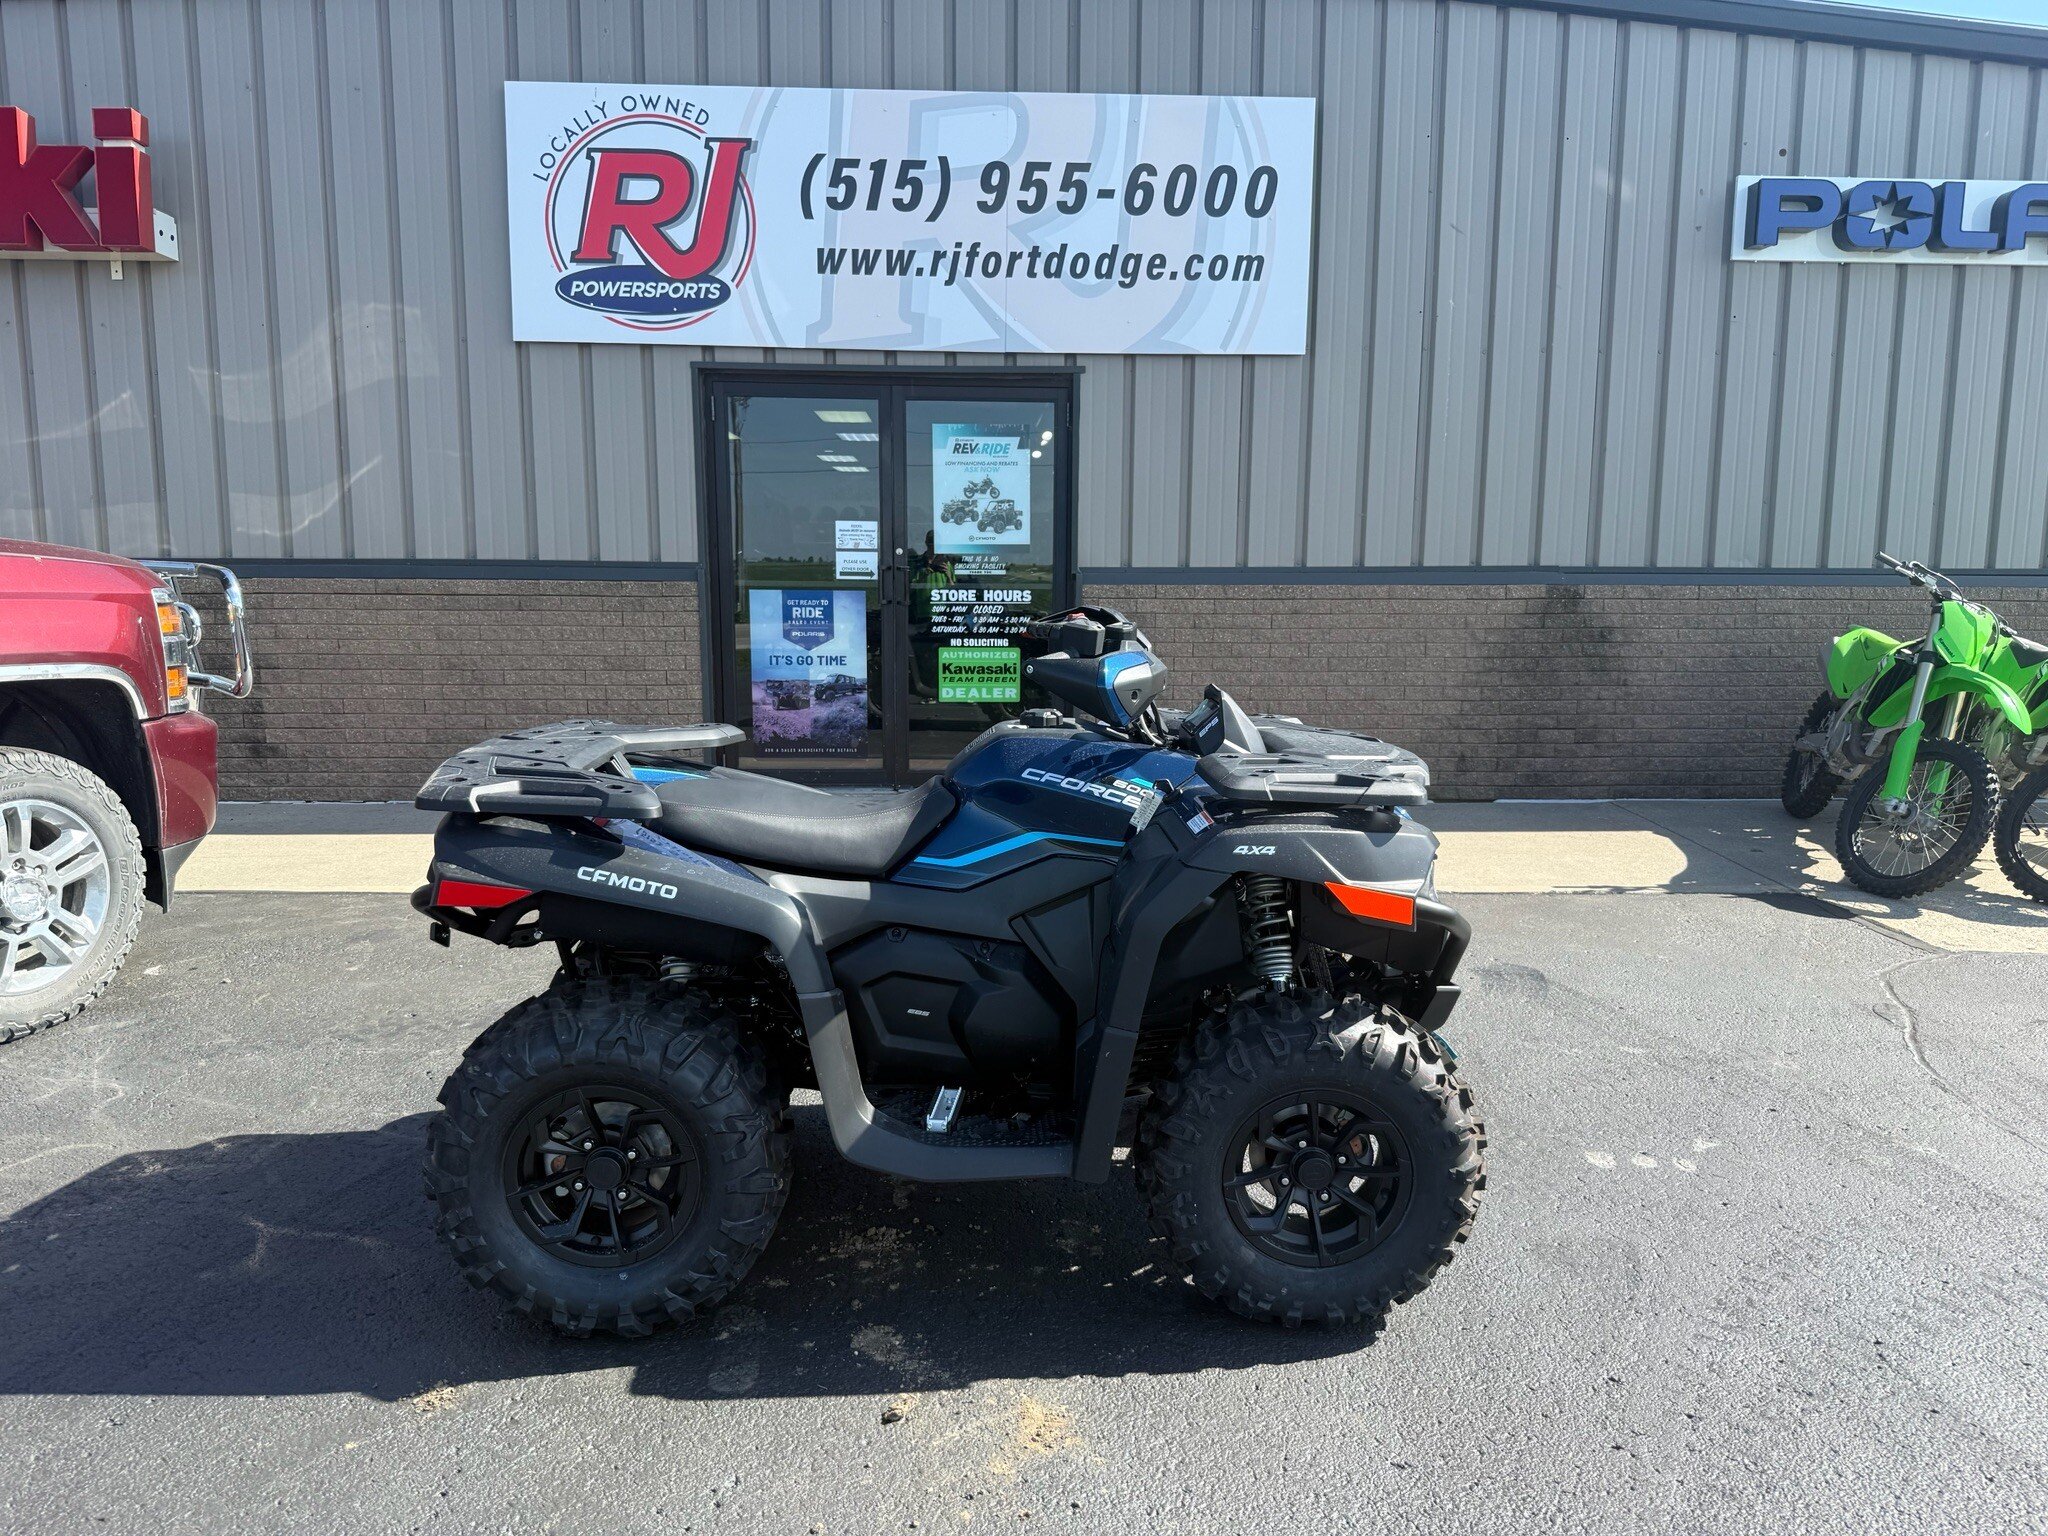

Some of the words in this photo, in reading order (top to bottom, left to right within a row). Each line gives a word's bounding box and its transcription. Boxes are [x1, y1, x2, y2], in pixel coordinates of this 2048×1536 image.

[533, 101, 608, 182] LOCALLY
[621, 94, 710, 126] OWNED
[800, 153, 951, 222] (515)
[976, 160, 1279, 219] 955-6000
[570, 137, 755, 281] RJ
[816, 241, 1266, 290] www.rjfortdodge.com
[570, 280, 722, 300] POWERSPORTS
[930, 589, 977, 602] STORE
[983, 589, 1032, 602] HOURS
[792, 607, 824, 619] RIDE
[972, 605, 1004, 614] CLOSED
[950, 638, 962, 647] NO
[963, 638, 1009, 647] SOLICITING
[769, 655, 793, 666] IT'S
[796, 655, 814, 666] GO
[817, 655, 848, 666] TIME
[942, 651, 1017, 659] AUTHORIZED
[942, 663, 1017, 675] Kawasaki
[941, 687, 1017, 698] DEALER
[1199, 716, 1219, 738] EPS
[1021, 767, 1143, 809] CFORCE
[576, 866, 678, 900] CFMOTO
